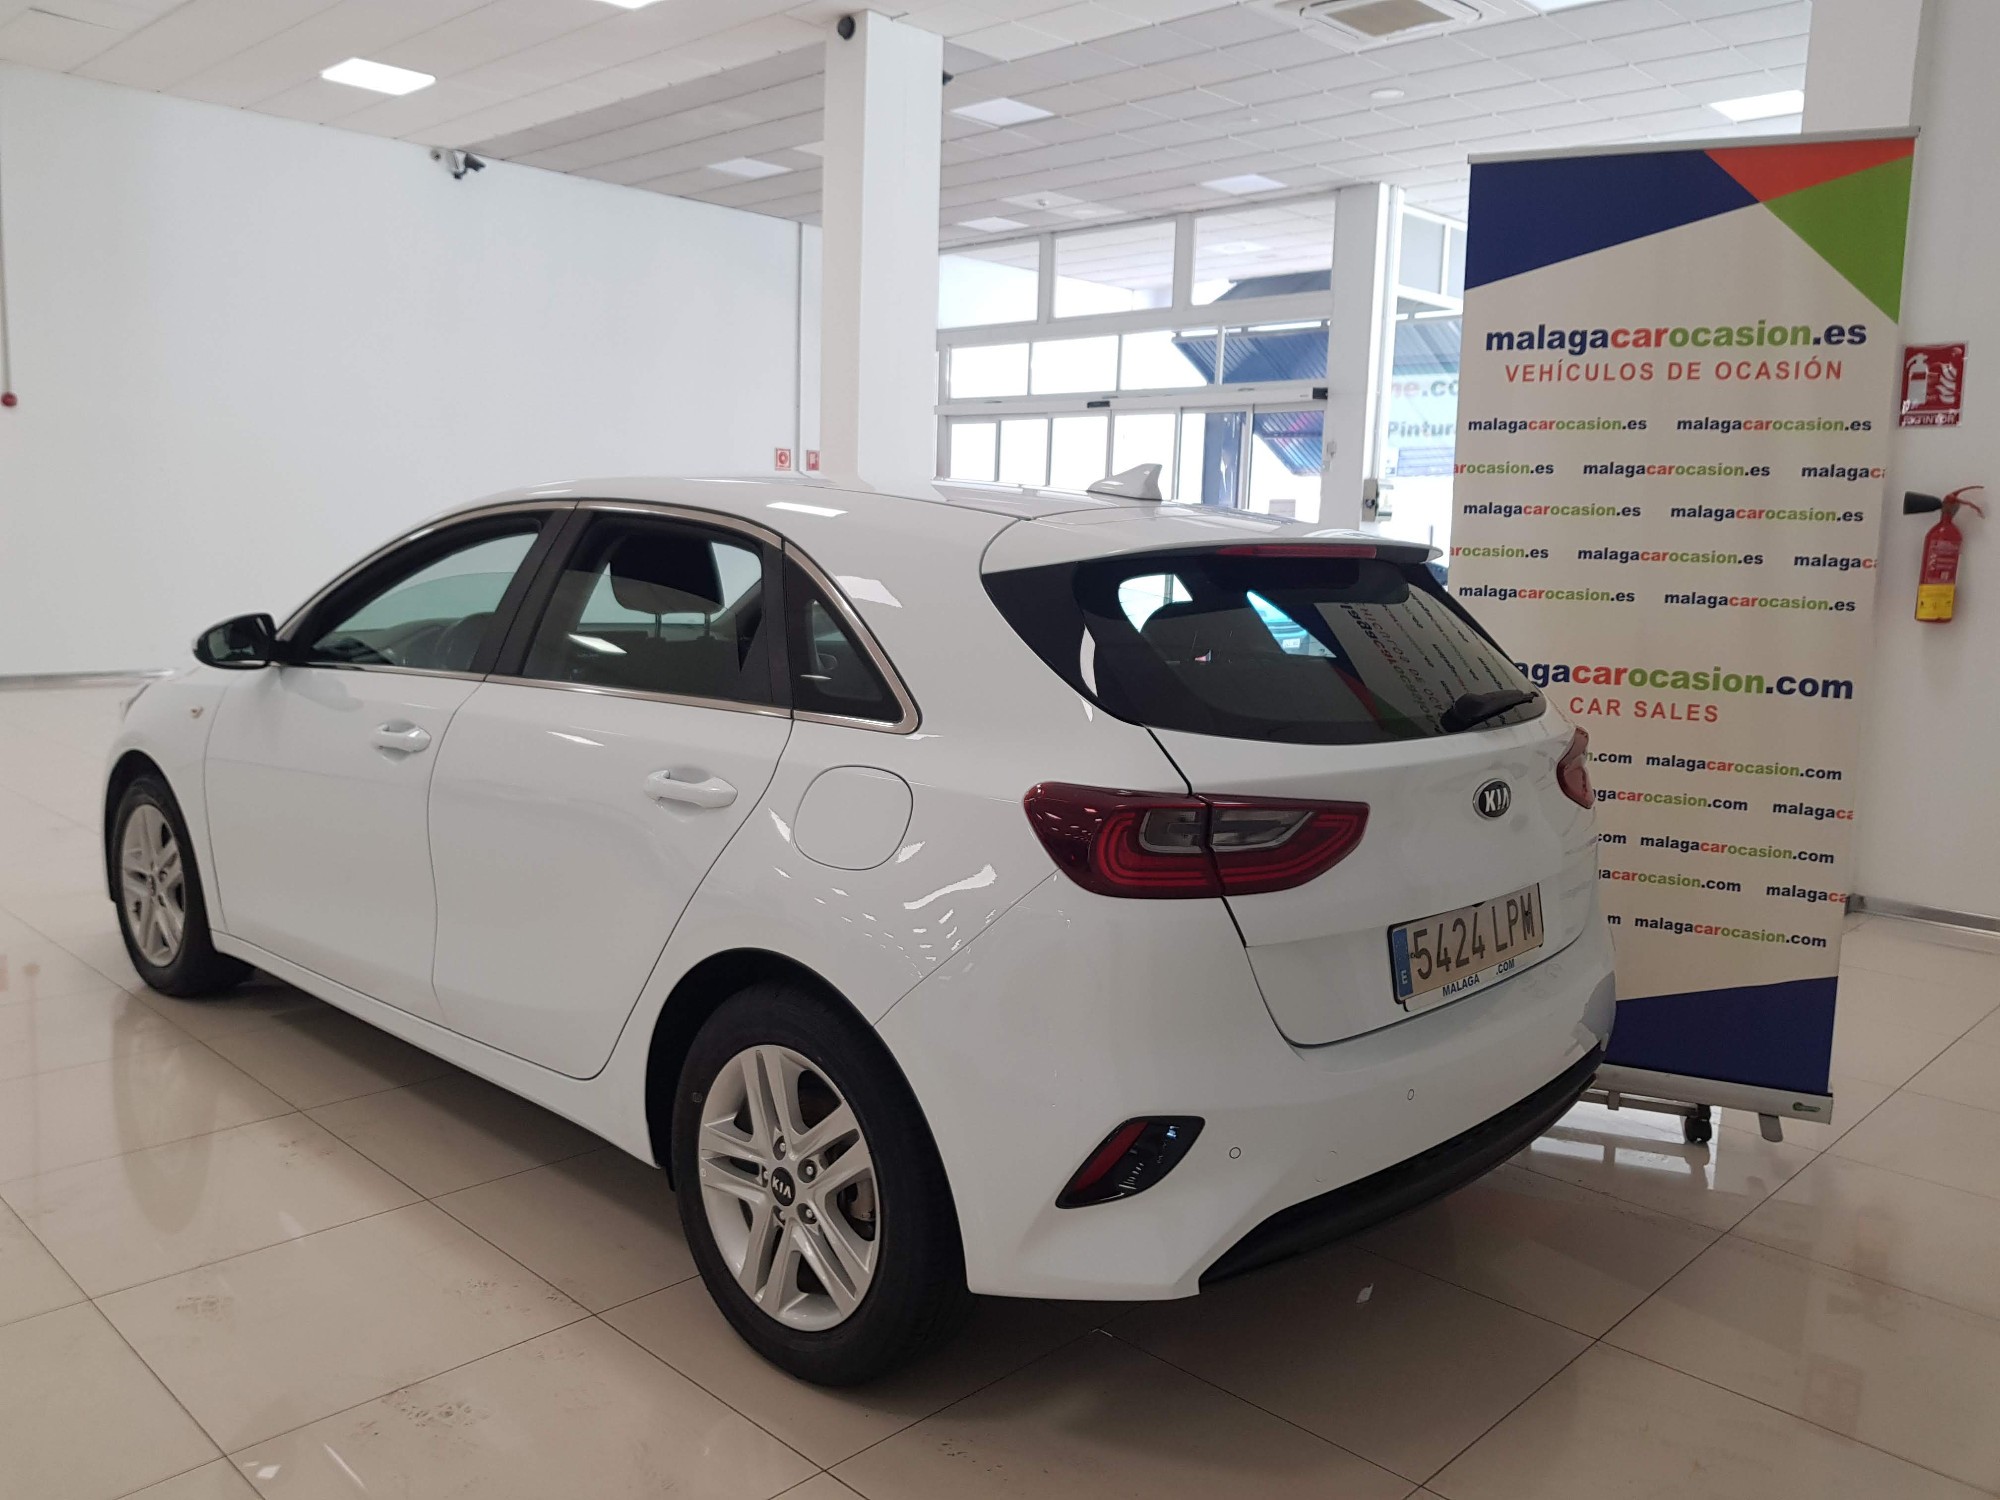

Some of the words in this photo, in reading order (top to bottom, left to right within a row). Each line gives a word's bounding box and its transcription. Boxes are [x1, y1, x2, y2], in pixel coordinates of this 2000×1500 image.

[1486, 320, 1867, 355] malagacarocasion.es
[1506, 359, 1653, 382] VEHÍCULOS
[1668, 362, 1700, 380] DE
[1715, 356, 1841, 380] OCASIÓN
[1388, 421, 1457, 438] Pintur
[1468, 417, 1647, 433] malagacarocasion.es
[1677, 417, 1871, 433] malagacarocasion.es
[1583, 462, 1770, 478] malagacarocasion.es
[1464, 502, 1641, 517] malagacarocasion.es
[1671, 505, 1863, 522] malagacarocasion.es
[1578, 547, 1763, 565] malagacarocasion.es
[1459, 585, 1635, 602] malagacarocasion.es
[1665, 592, 1855, 611] malagacarocasion.es
[1570, 697, 1620, 716] CAR
[1634, 701, 1717, 722] SALES
[1646, 755, 1841, 780] malagacarocasion.com
[1484, 787, 1510, 812] KIA
[1640, 836, 1834, 864] malagacarocasion.com
[1599, 869, 1741, 892] acarocasion.com
[1413, 912, 1486, 980] 5424
[1491, 892, 1536, 952] LPM
[1635, 917, 1826, 947] malagacarocasion.com
[1400, 969, 1409, 985] E
[1442, 973, 1480, 997] MALAGA
[1495, 958, 1515, 976] .COM
[771, 1175, 792, 1199] KIA
